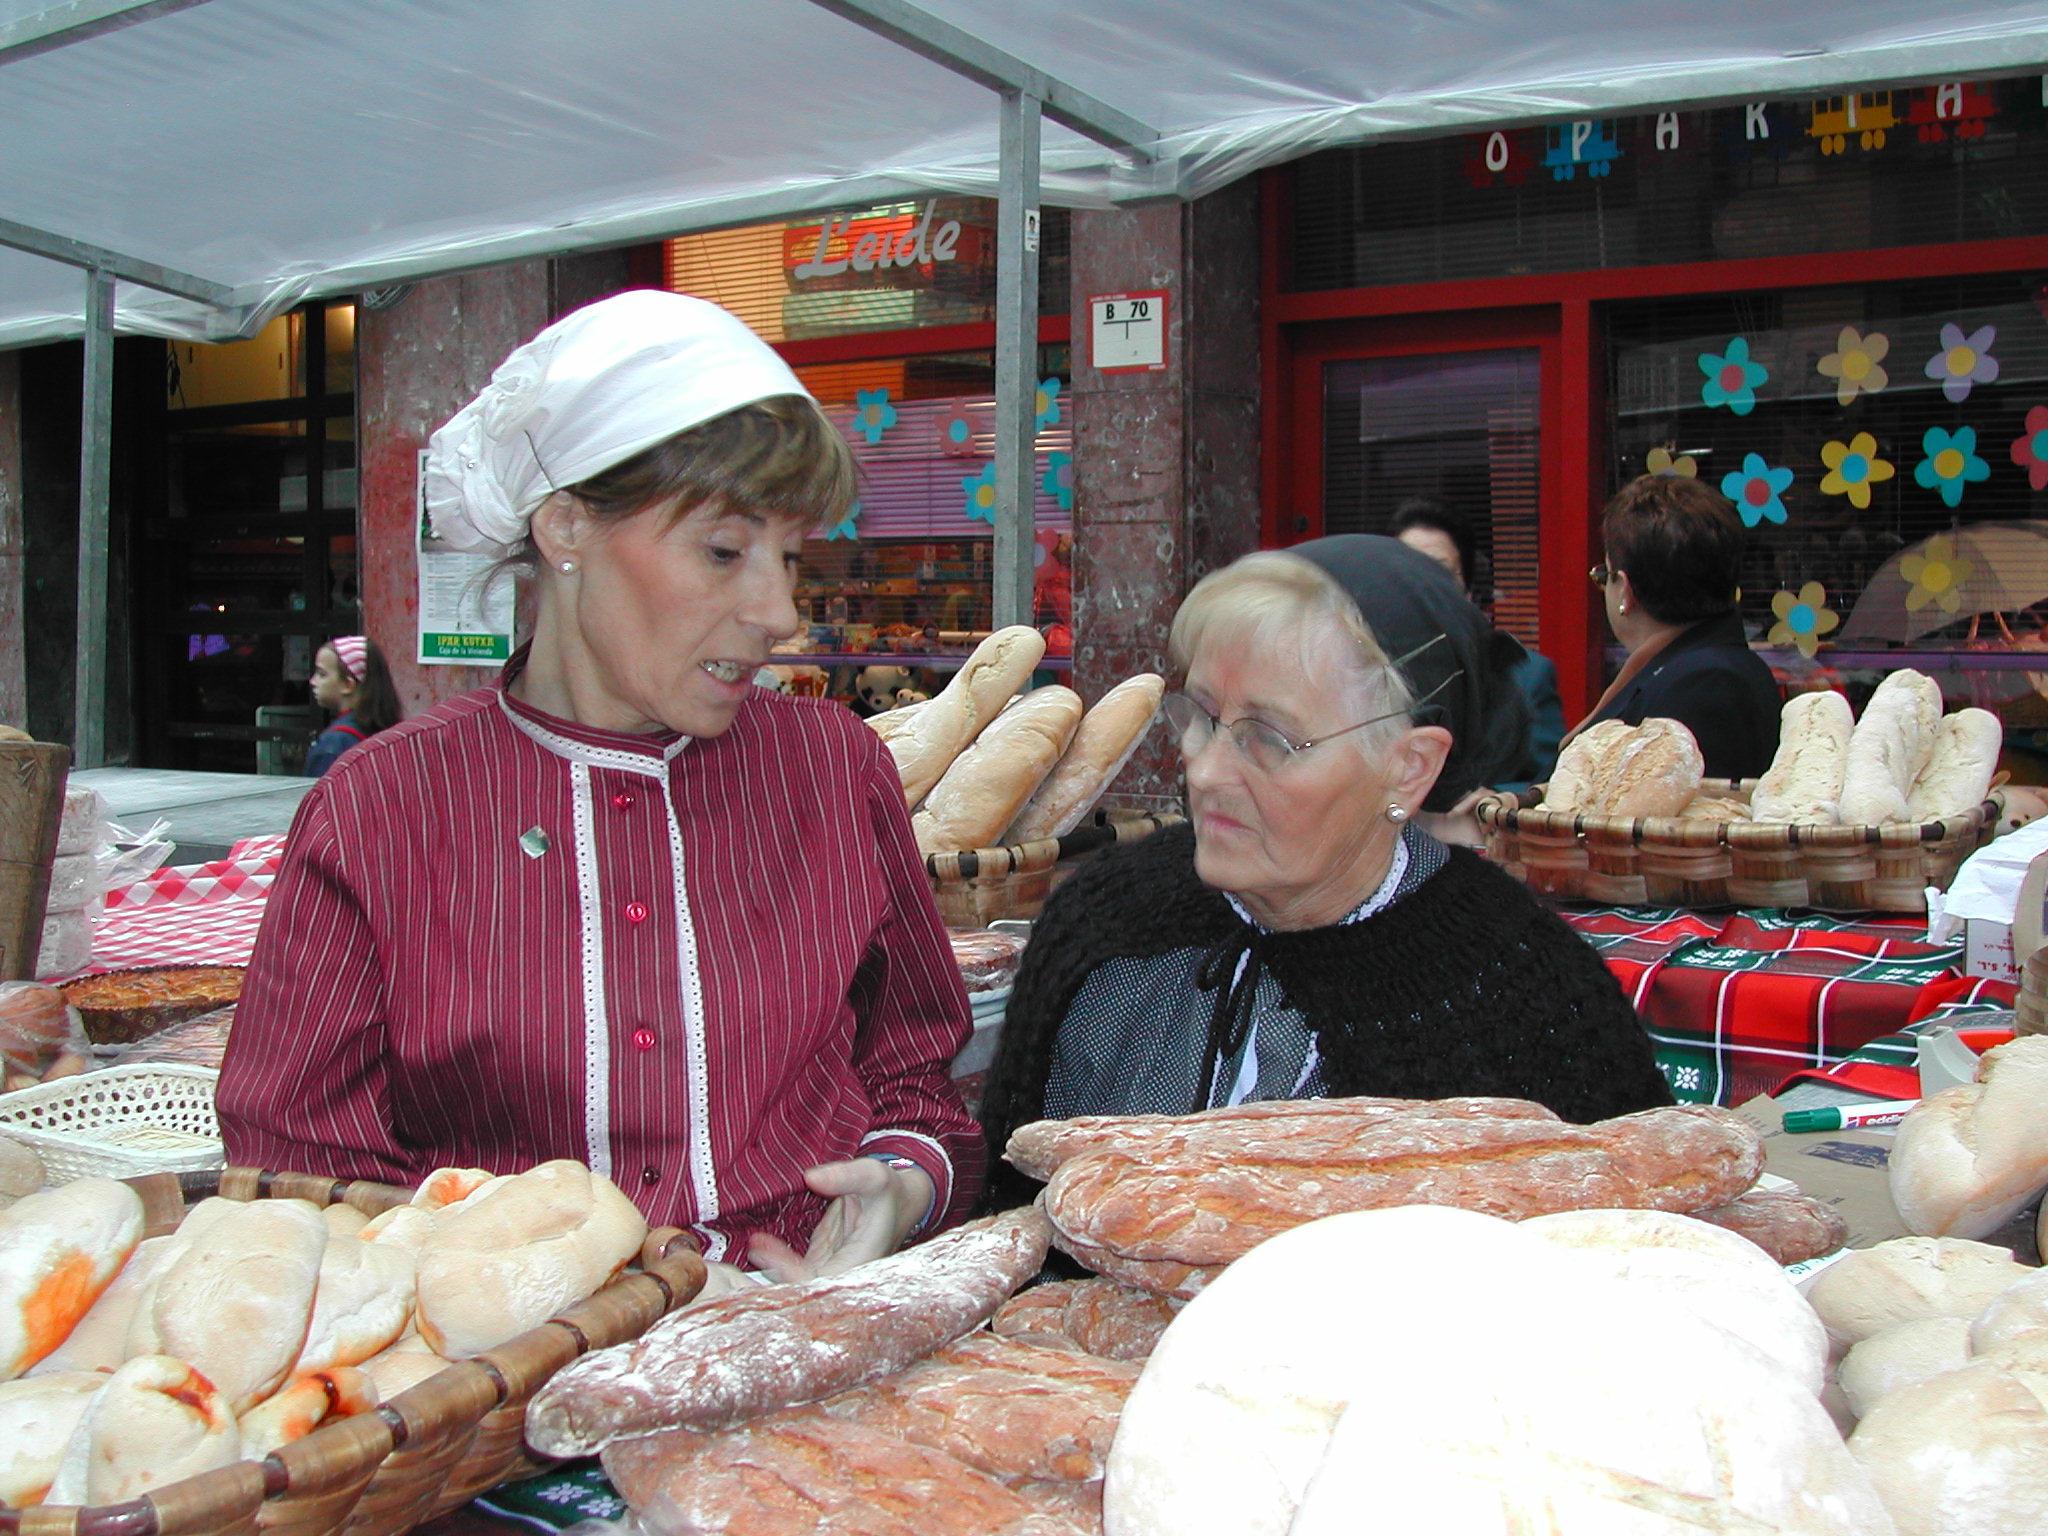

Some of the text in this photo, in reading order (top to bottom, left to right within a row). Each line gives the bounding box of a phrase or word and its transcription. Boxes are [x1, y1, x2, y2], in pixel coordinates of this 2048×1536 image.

[1106, 301, 1148, 320] B 70
[462, 636, 495, 647] KUTXA
[452, 647, 460, 655] de
[461, 647, 467, 655] la
